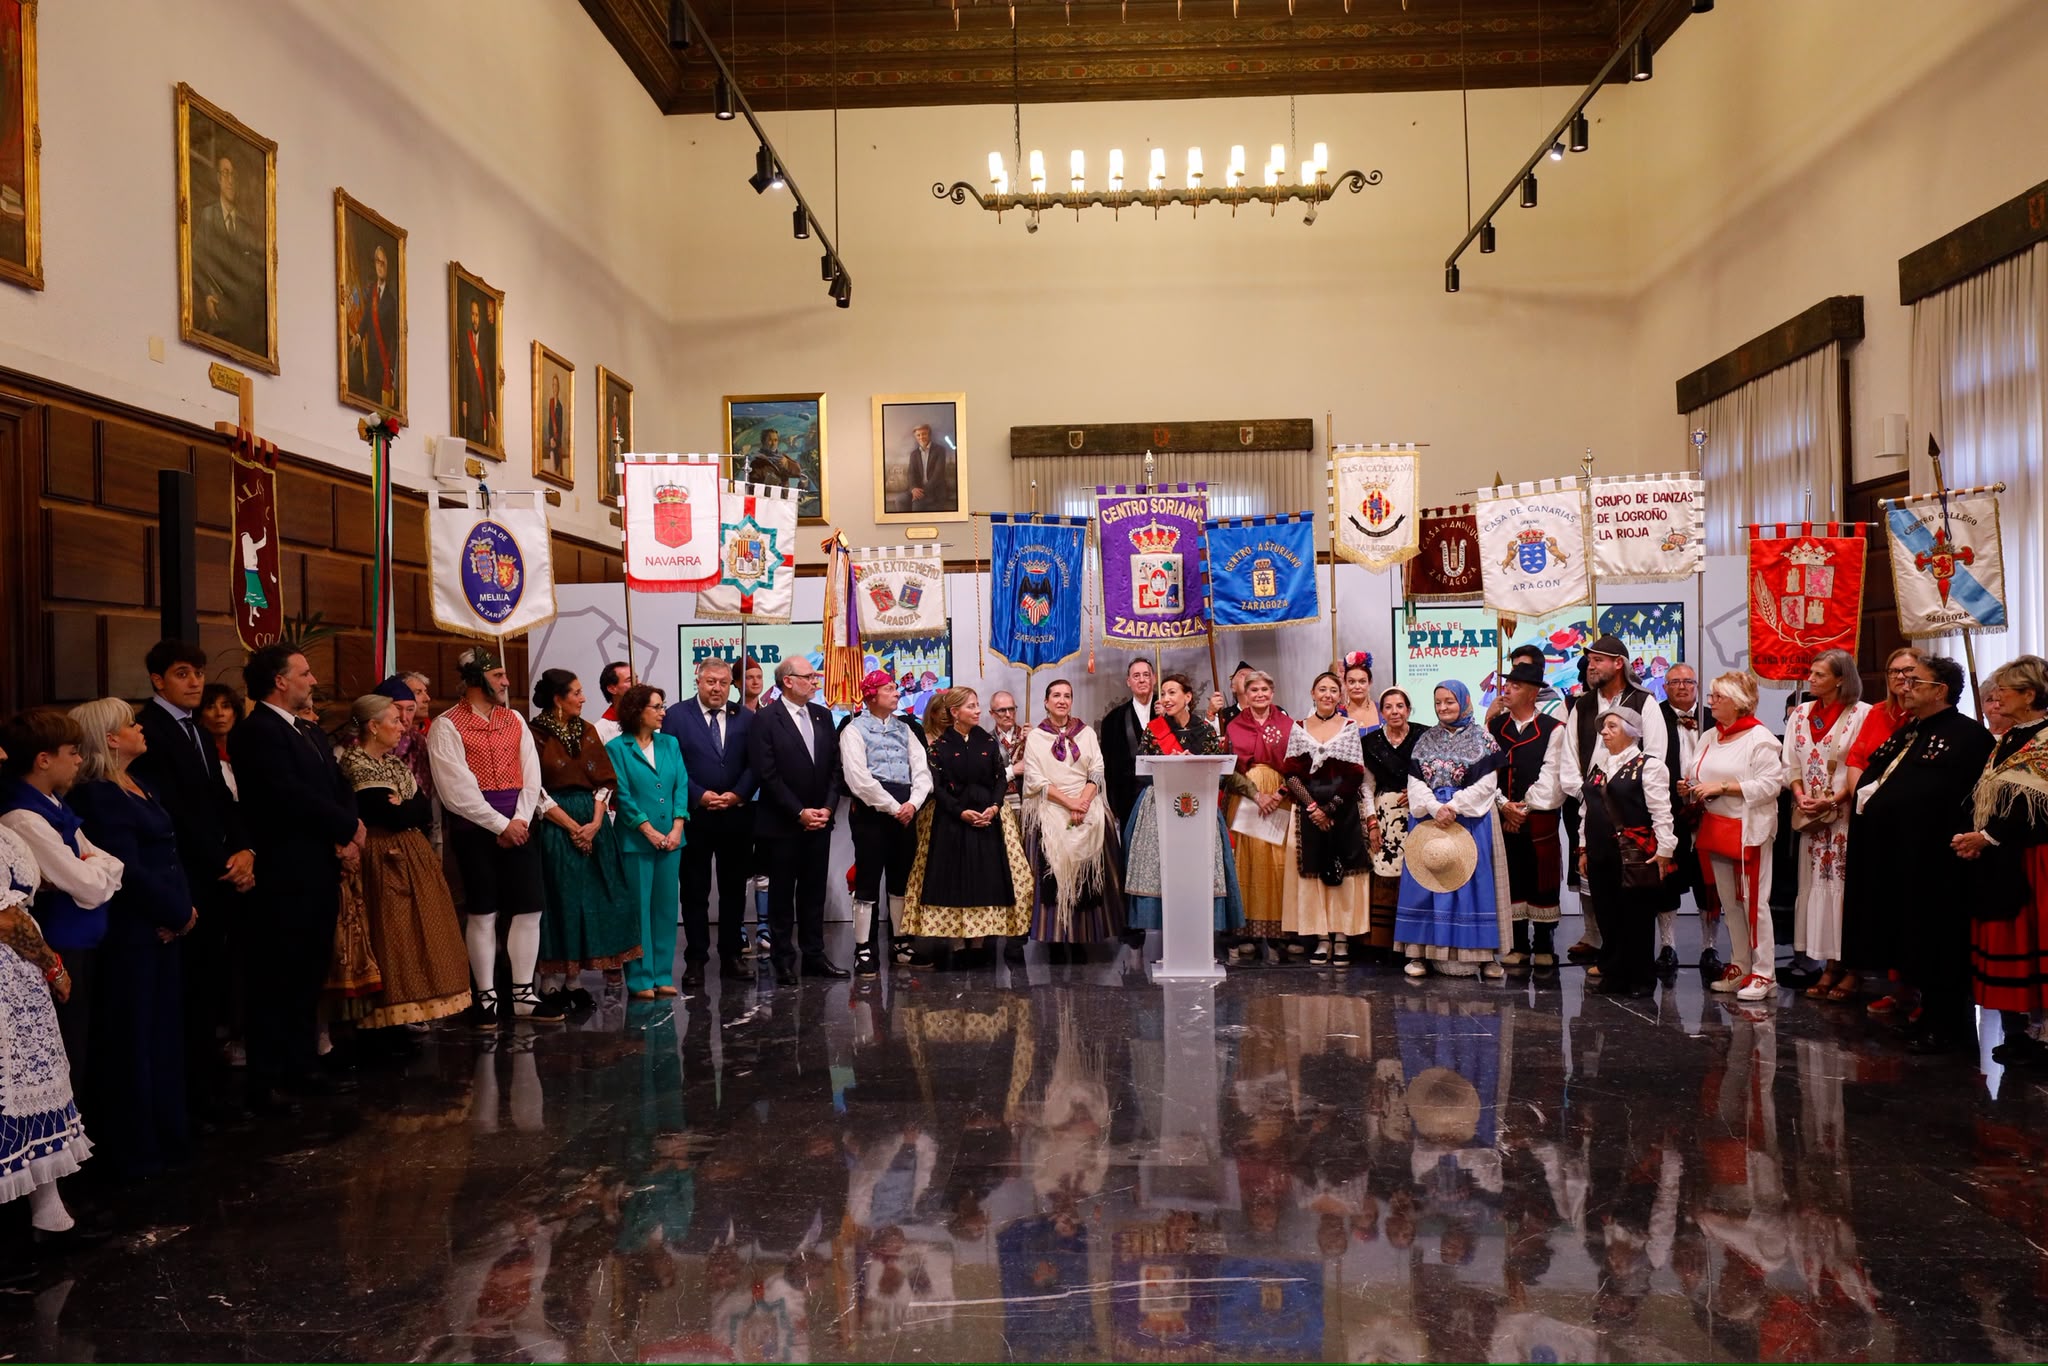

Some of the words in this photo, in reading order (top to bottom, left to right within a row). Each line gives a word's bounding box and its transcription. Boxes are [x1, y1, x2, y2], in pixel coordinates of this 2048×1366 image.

[1595, 494, 1631, 508] GRUPO
[1636, 493, 1648, 504] DE
[1653, 492, 1693, 503] DANZAS
[1101, 498, 1148, 524] CENTRO
[1597, 513, 1610, 523] DE
[1616, 508, 1667, 522] LOGROÑO
[1484, 514, 1508, 532] CASA
[1510, 507, 1522, 516] DE
[1527, 505, 1576, 523] CANARIAS
[1904, 514, 1935, 535] CENTRO
[497, 532, 508, 542] DE
[1599, 529, 1613, 540] LA
[1616, 527, 1649, 539] RIOJA
[645, 556, 701, 566] NAVARRA
[1225, 546, 1252, 572] CENTRO
[1258, 541, 1303, 568] ASTURIANO
[1512, 579, 1561, 591] ARAGON
[1241, 600, 1288, 610] ZARAGOZA
[874, 612, 921, 626] ZARAGOZA
[1926, 613, 1970, 623] ZARAGOZA
[1112, 616, 1207, 638] ZARAGOZA
[1408, 621, 1441, 631] FIESTAS
[1447, 621, 1463, 630] DEL
[693, 637, 724, 647] FIESTAS
[1014, 633, 1054, 644] ZARAGOZA
[1408, 629, 1497, 648] PILAR
[692, 644, 781, 664] PILAR
[1409, 646, 1479, 659] ZARAGOZA
